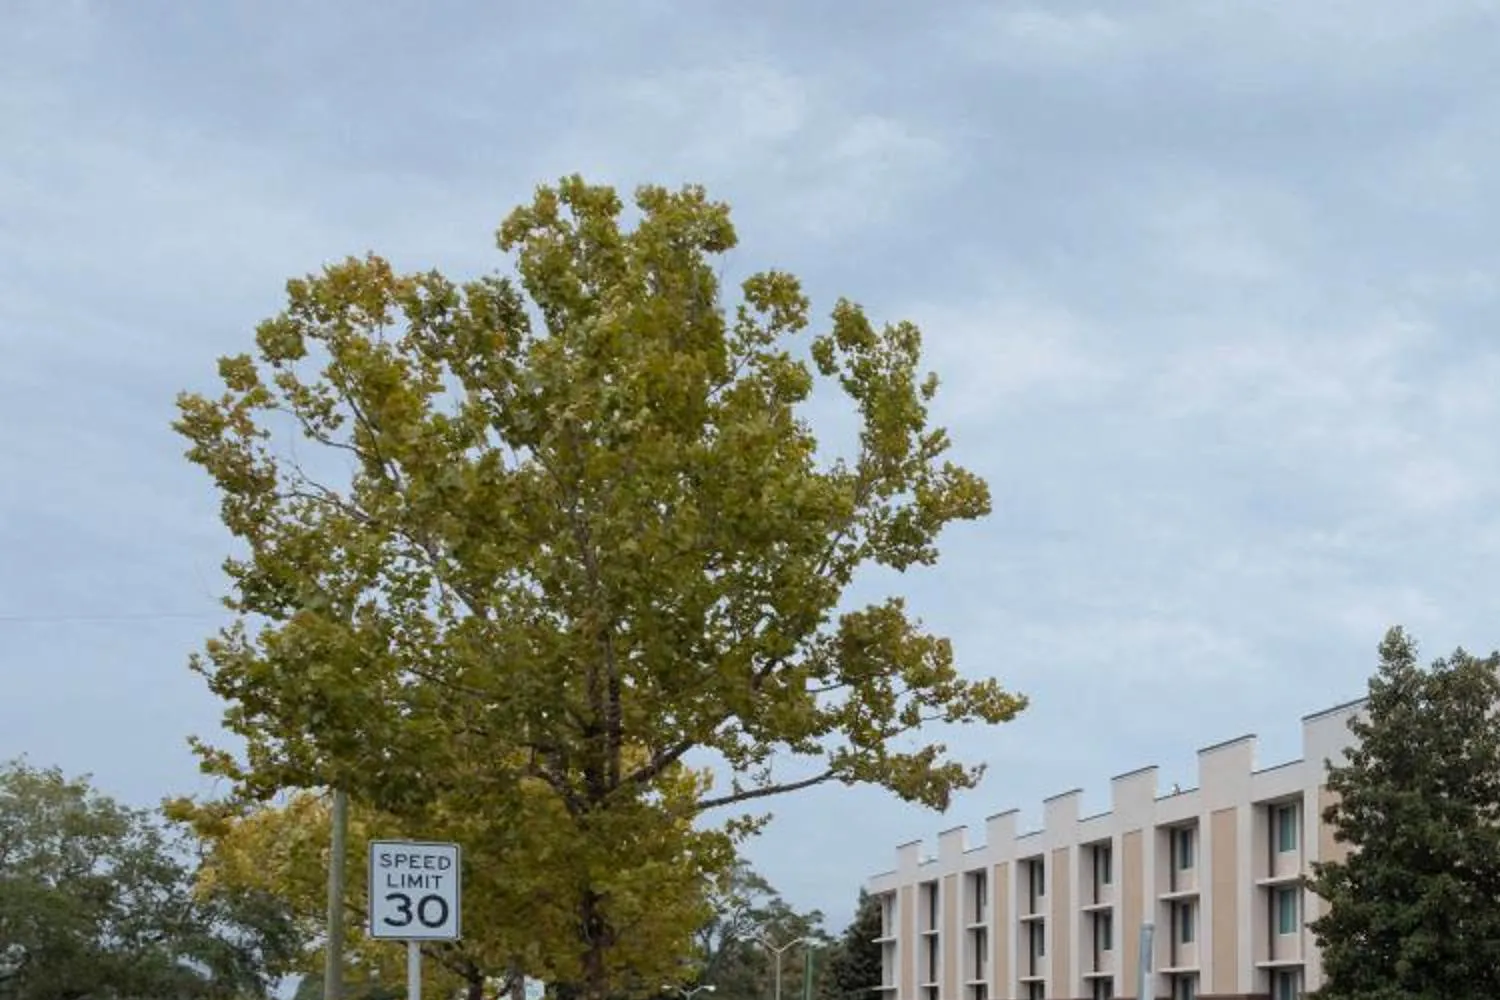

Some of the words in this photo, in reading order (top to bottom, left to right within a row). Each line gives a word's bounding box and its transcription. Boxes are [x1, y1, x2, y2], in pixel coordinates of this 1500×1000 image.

[380, 853, 452, 871] SPEED
[387, 873, 443, 889] LIMIT
[383, 892, 449, 928] 30
